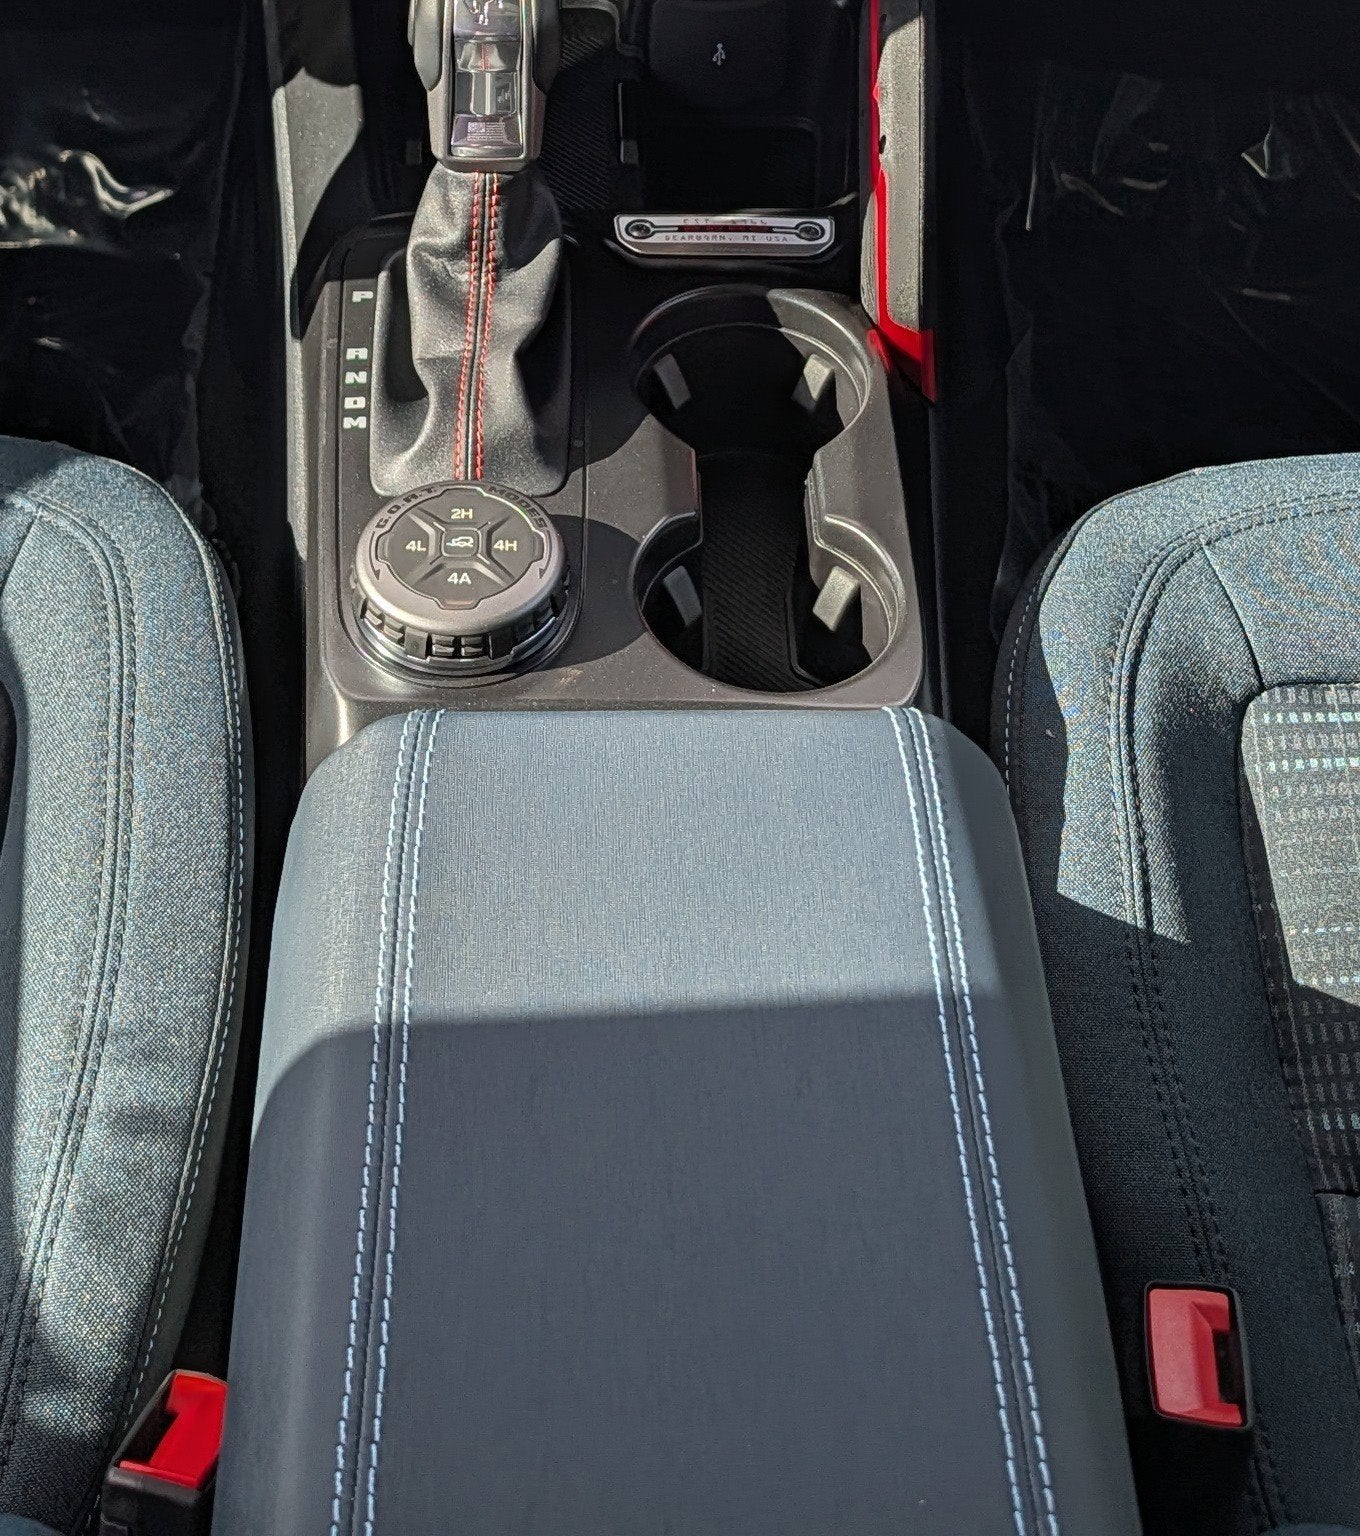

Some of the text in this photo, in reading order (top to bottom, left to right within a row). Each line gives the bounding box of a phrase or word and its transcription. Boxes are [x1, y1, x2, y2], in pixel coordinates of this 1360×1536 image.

[351, 290, 374, 303] P
[345, 371, 367, 385] N
[344, 396, 366, 409] D
[343, 416, 367, 430] M
[450, 508, 473, 520] 2H
[405, 540, 426, 552] 4L
[493, 540, 517, 552] 4H
[447, 572, 472, 585] 4A
